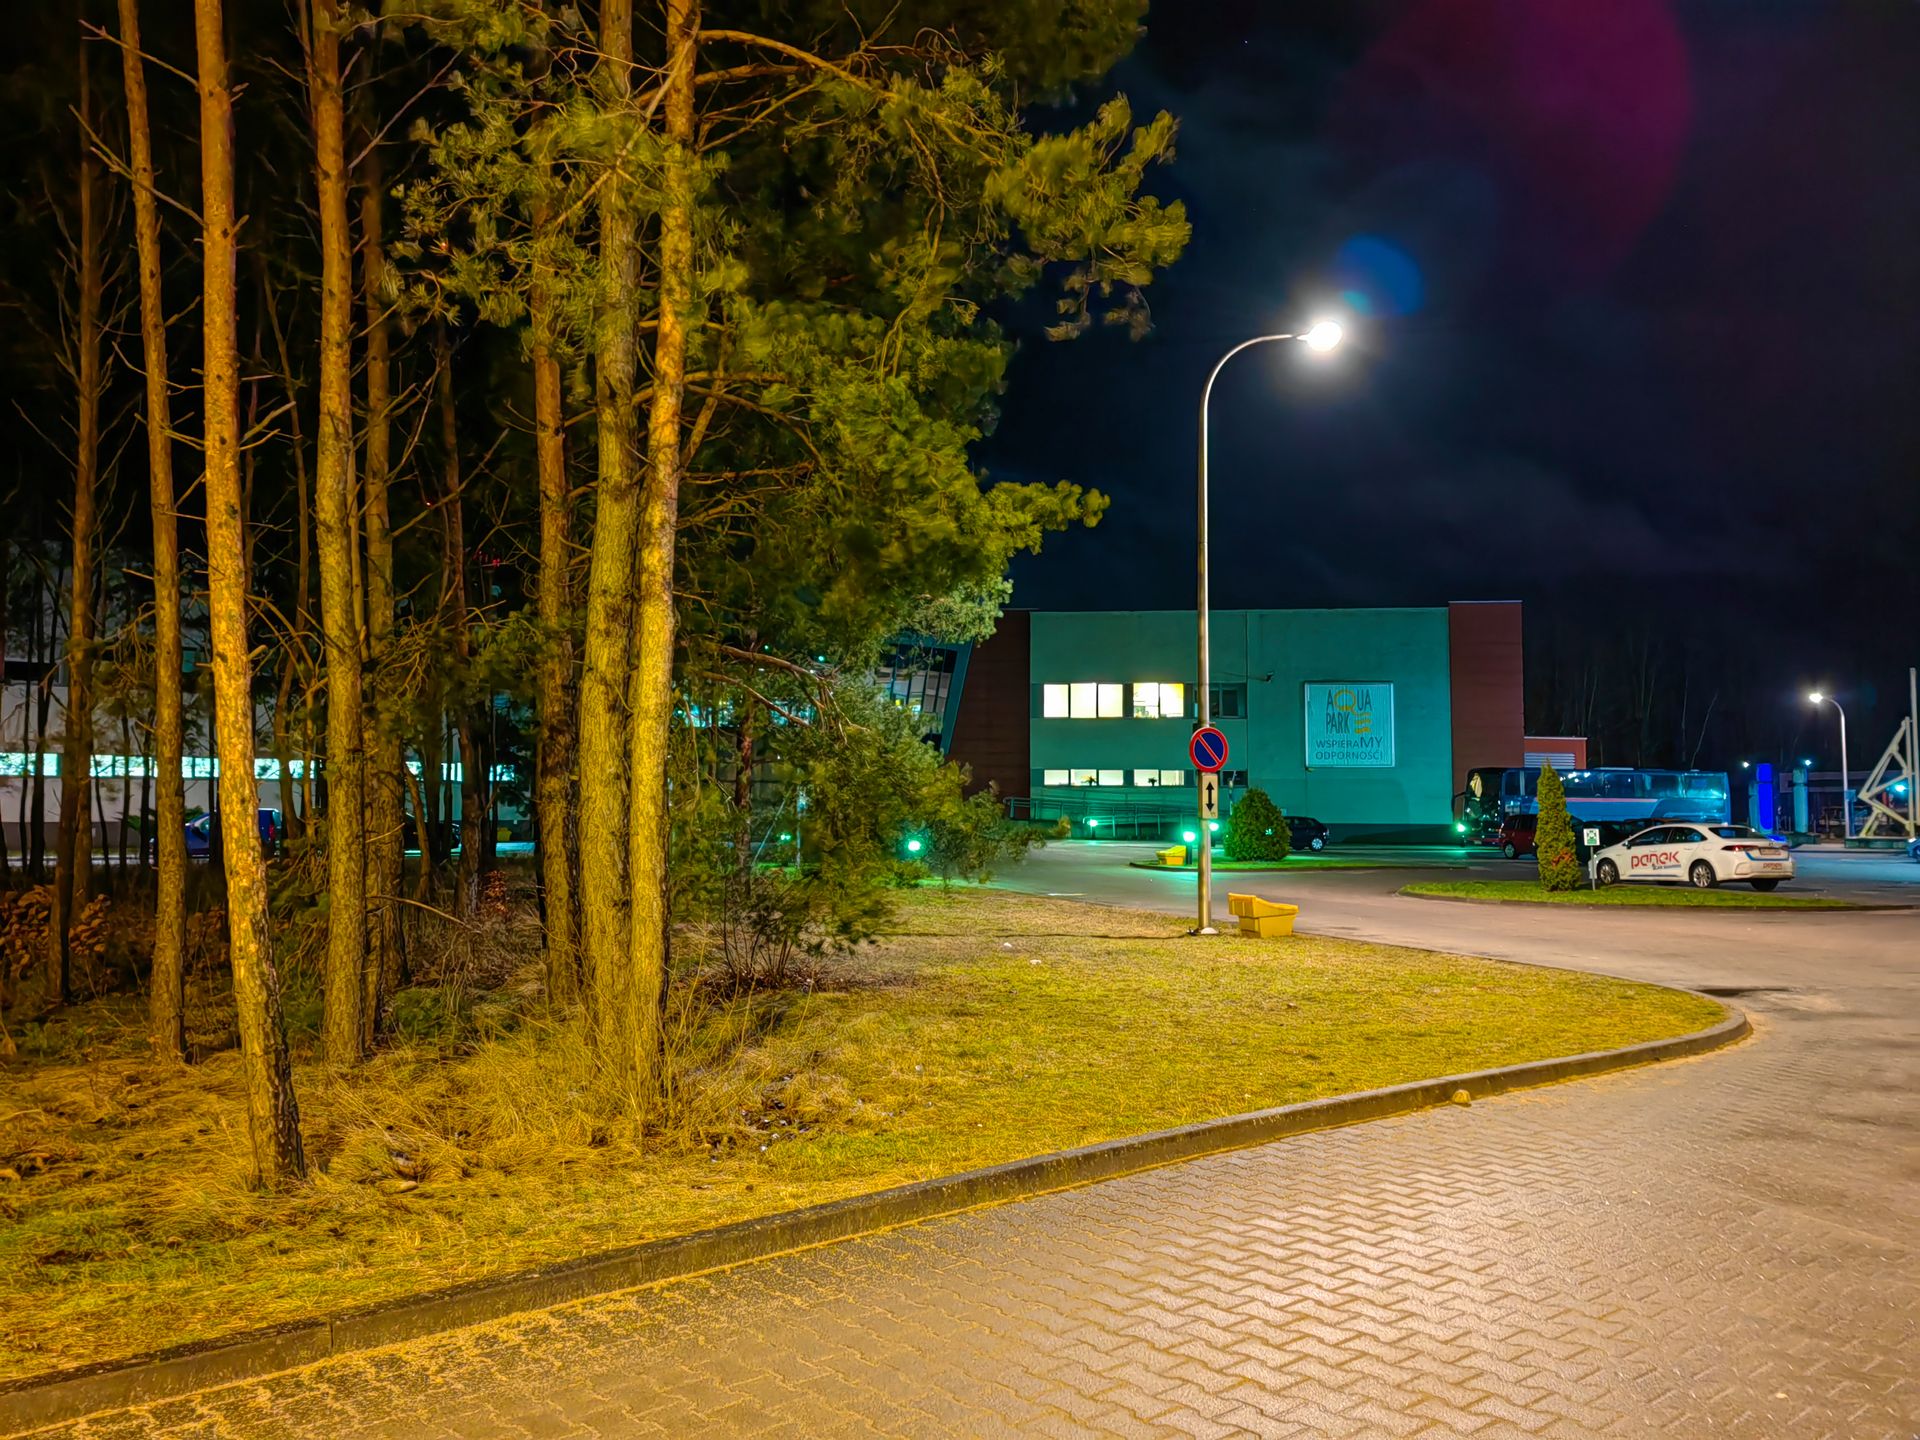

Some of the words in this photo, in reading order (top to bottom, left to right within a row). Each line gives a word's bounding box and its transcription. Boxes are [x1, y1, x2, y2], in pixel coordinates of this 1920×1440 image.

[1326, 689, 1373, 712] AQUA
[1326, 711, 1351, 734] PARK
[1316, 736, 1383, 748] WSPIERAMY
